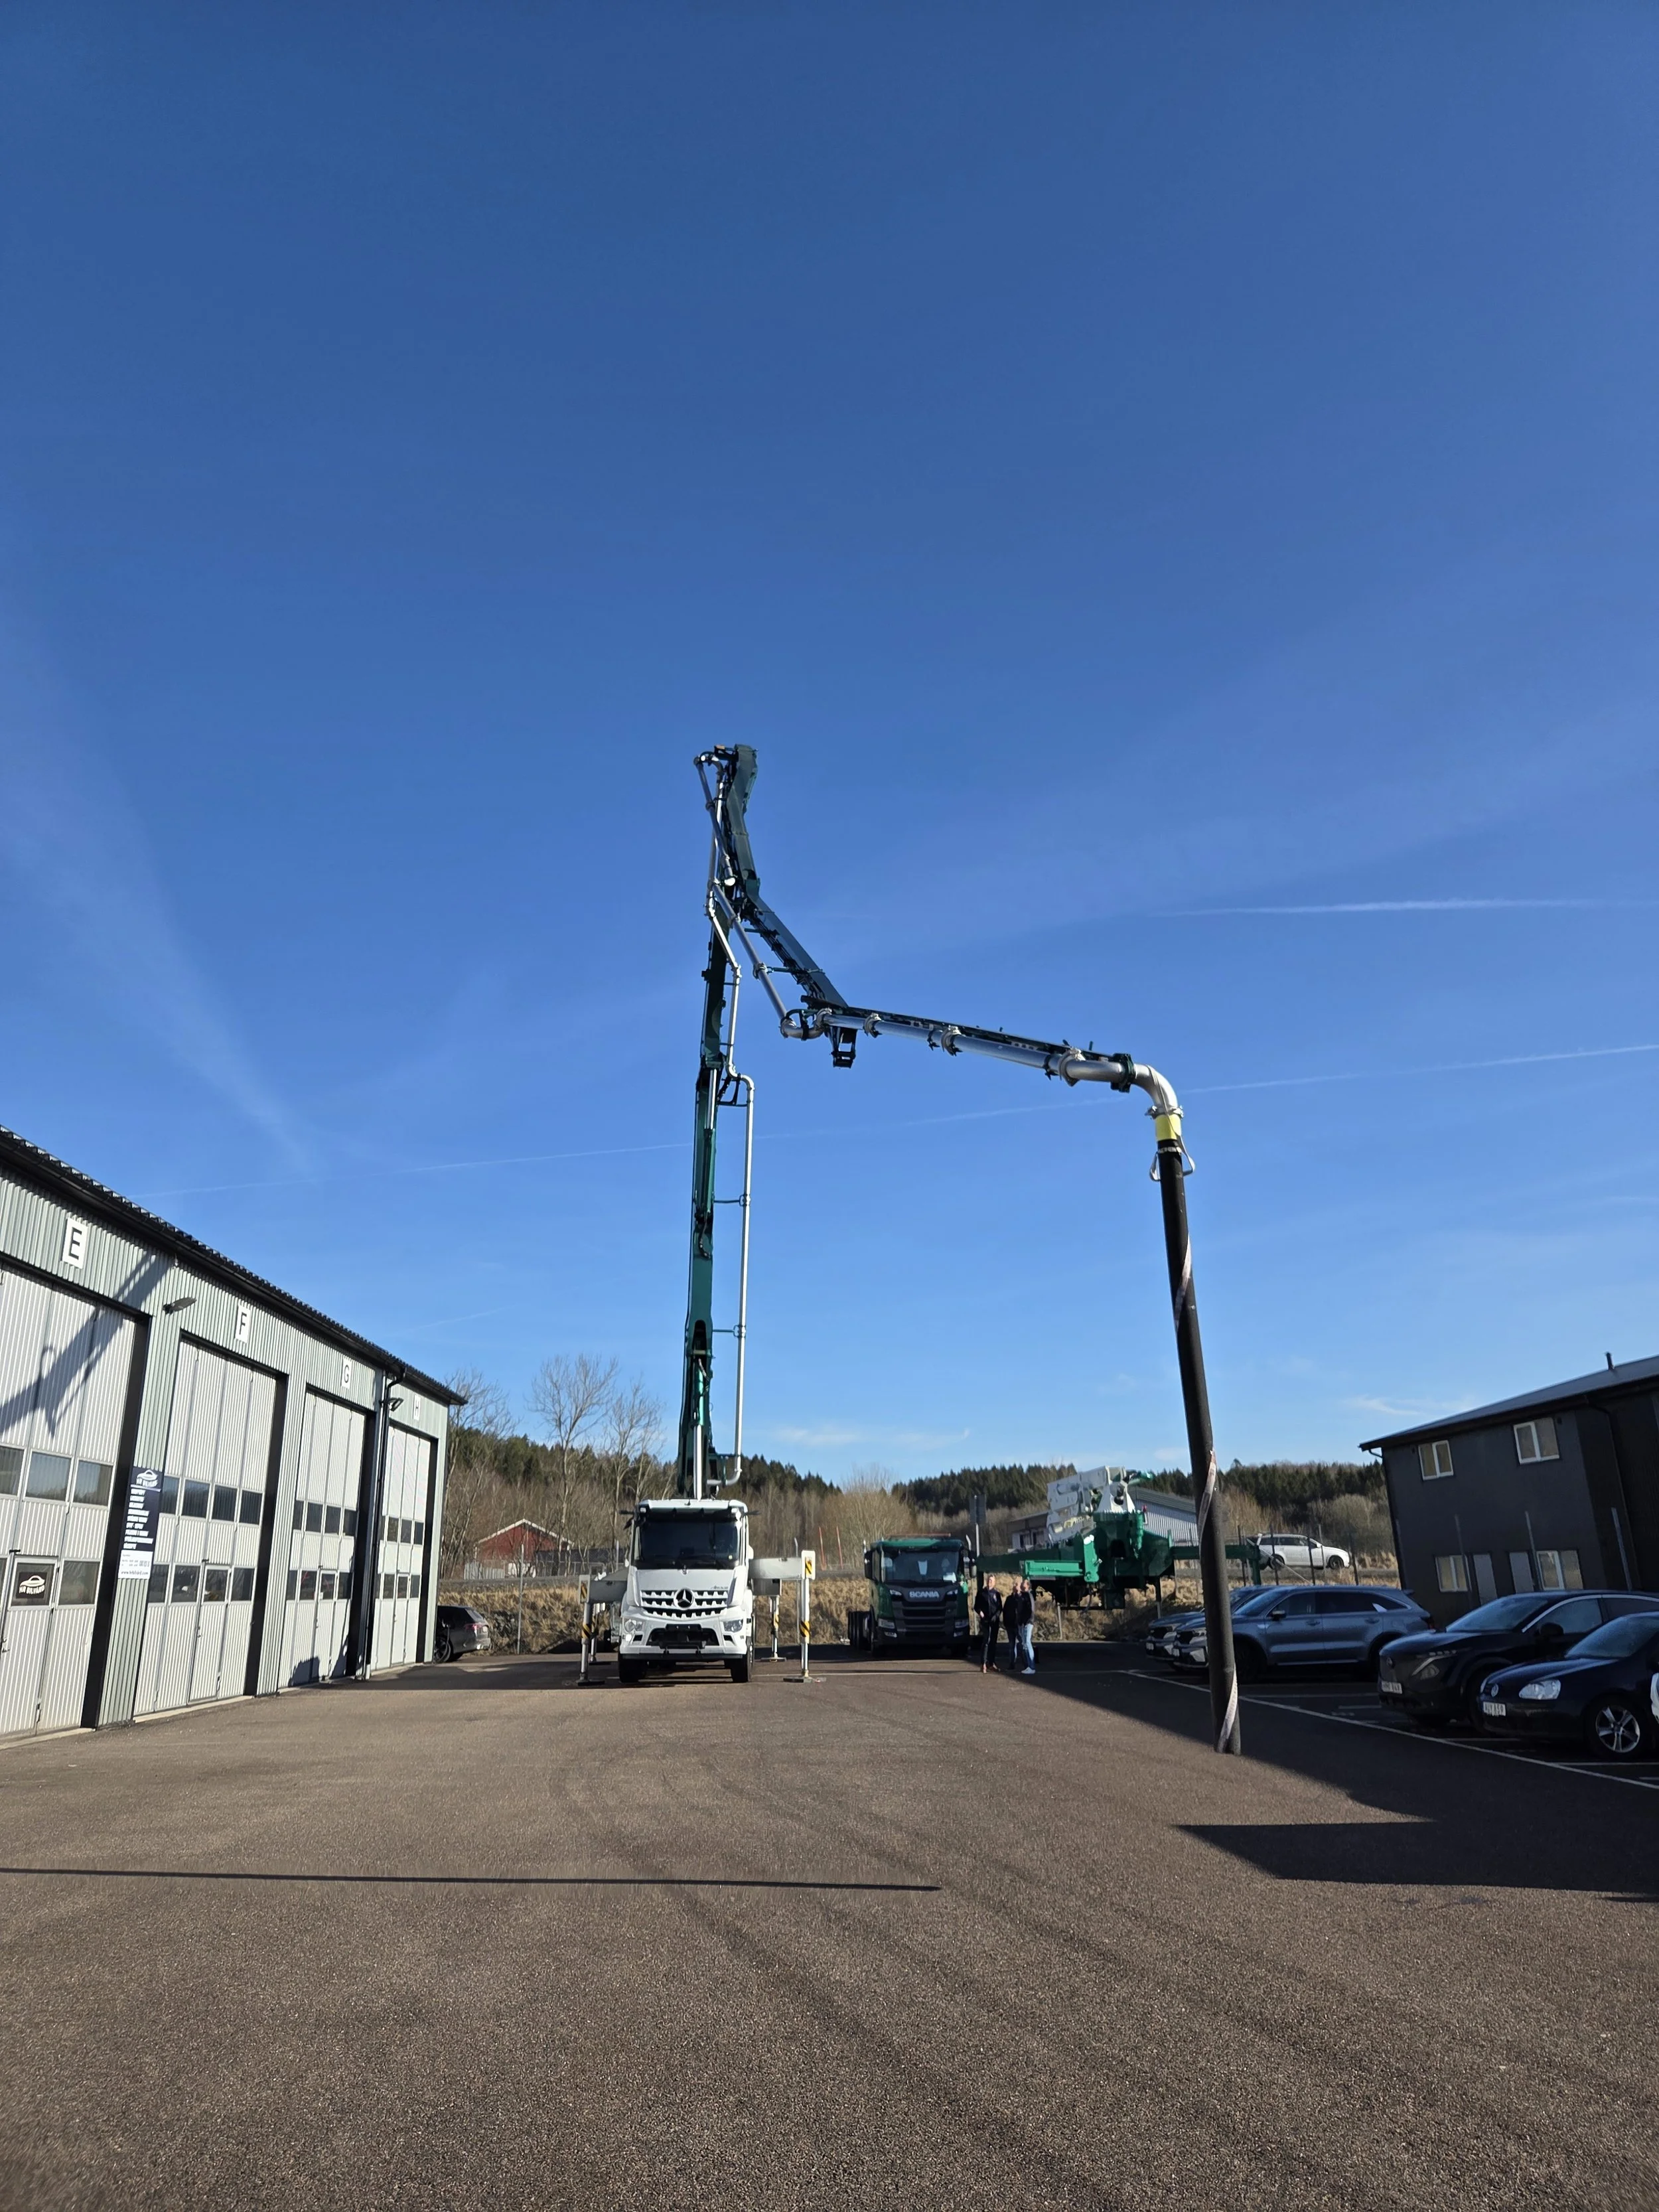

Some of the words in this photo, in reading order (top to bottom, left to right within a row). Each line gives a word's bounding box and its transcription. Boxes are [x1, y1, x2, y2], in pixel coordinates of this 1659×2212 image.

[68, 1226, 82, 1260] E
[239, 1311, 247, 1335] F
[344, 1364, 350, 1383] G
[415, 1400, 419, 1416] H
